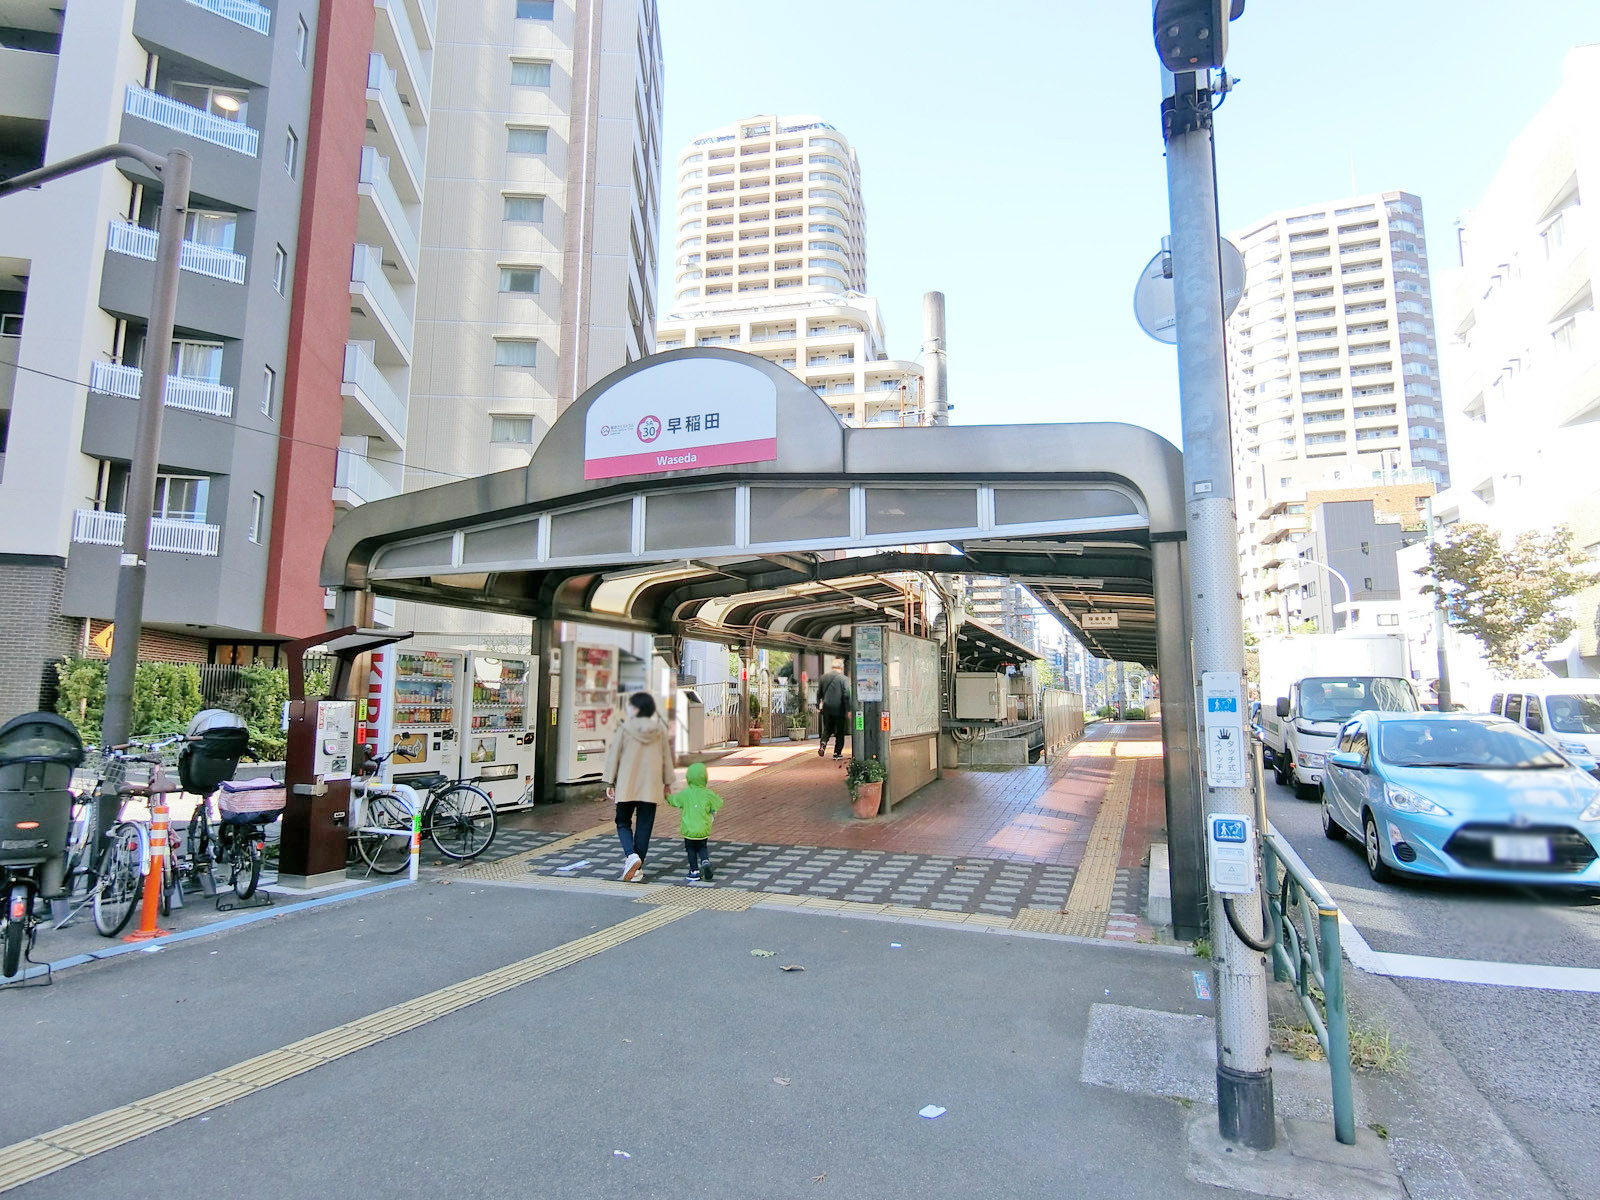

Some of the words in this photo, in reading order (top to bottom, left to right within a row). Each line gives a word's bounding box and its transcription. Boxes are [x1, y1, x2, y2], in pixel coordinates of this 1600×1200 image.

[643, 426, 656, 437] 30
[667, 413, 719, 434] 早稲田
[656, 452, 697, 466] Waseda
[1214, 740, 1223, 771] スイッチ
[1226, 740, 1236, 771] タッチ式
